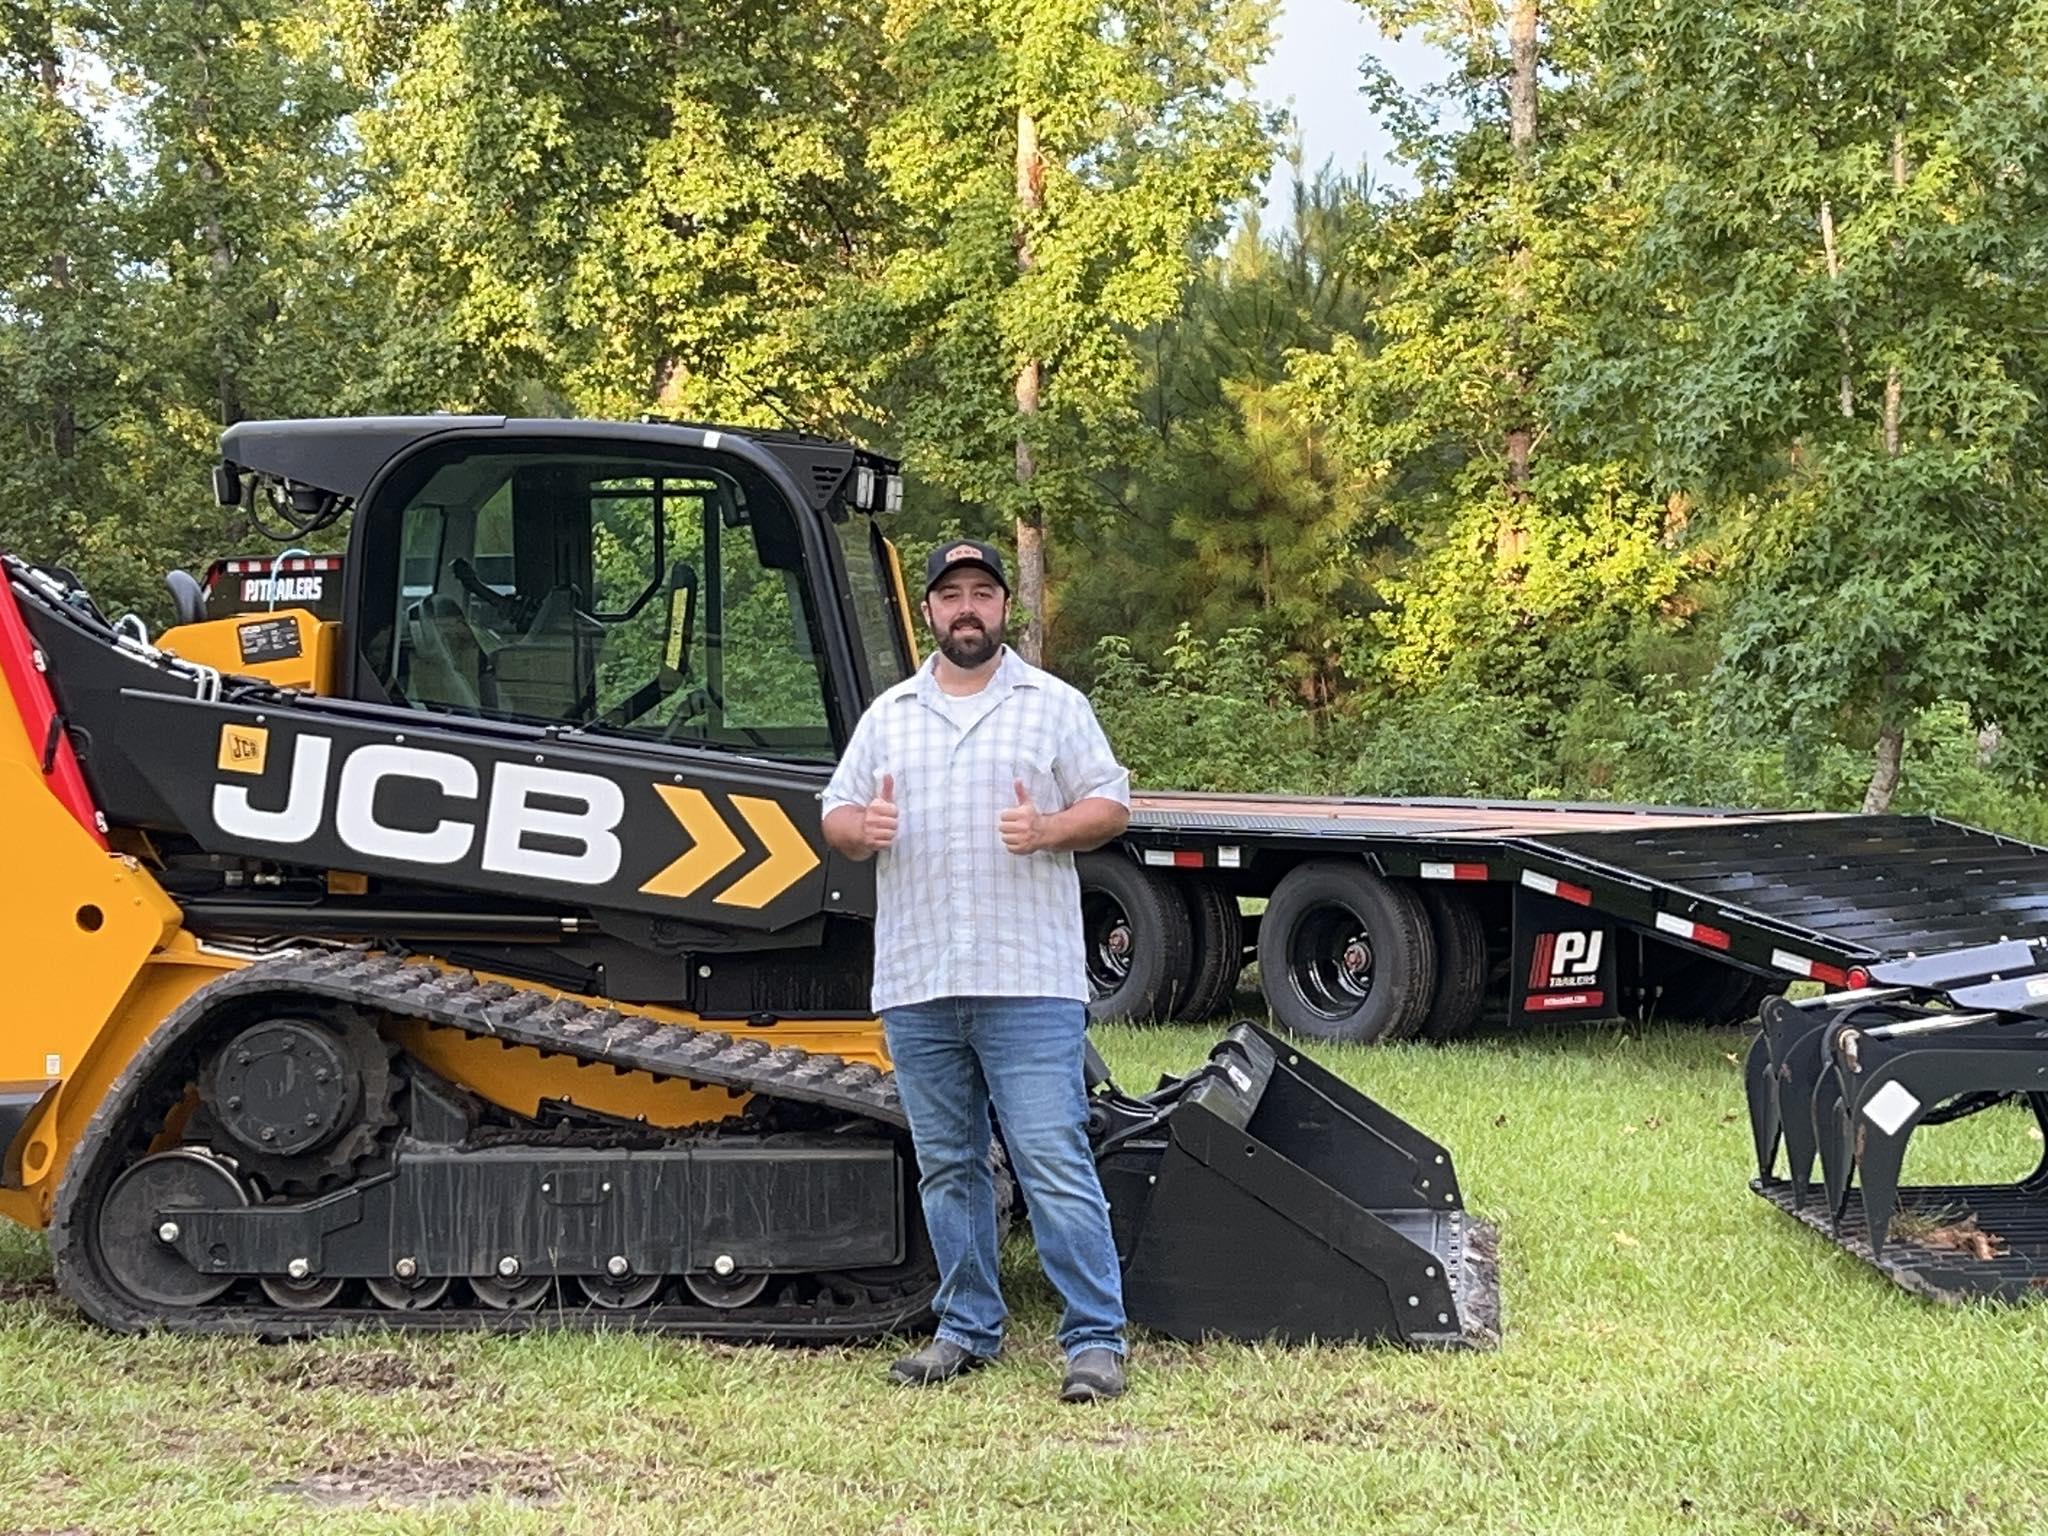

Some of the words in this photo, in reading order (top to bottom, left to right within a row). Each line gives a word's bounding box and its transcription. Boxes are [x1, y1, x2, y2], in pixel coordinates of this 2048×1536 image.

[233, 736, 257, 758] JCB
[212, 733, 625, 885] JCB
[1551, 930, 1604, 975] PJ
[1549, 974, 1597, 988] TRAILERS
